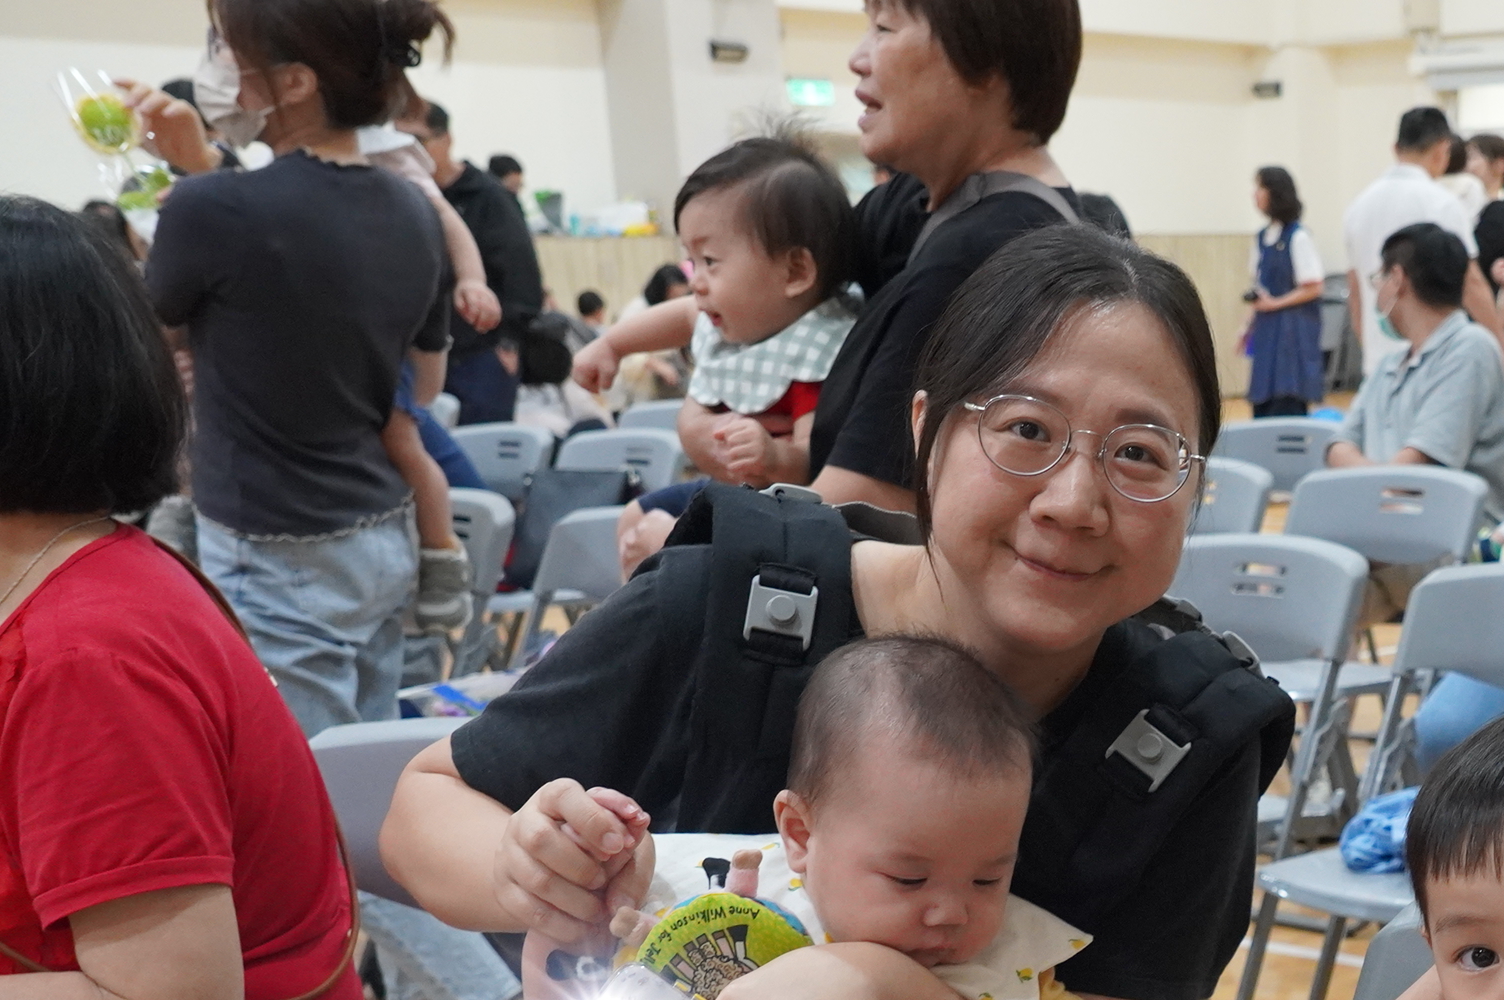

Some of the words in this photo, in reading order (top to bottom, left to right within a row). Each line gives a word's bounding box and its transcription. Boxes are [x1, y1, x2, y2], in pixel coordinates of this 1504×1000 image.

[670, 906, 727, 931] Wilkinson
[728, 905, 760, 919] Anne
[657, 929, 672, 943] for
